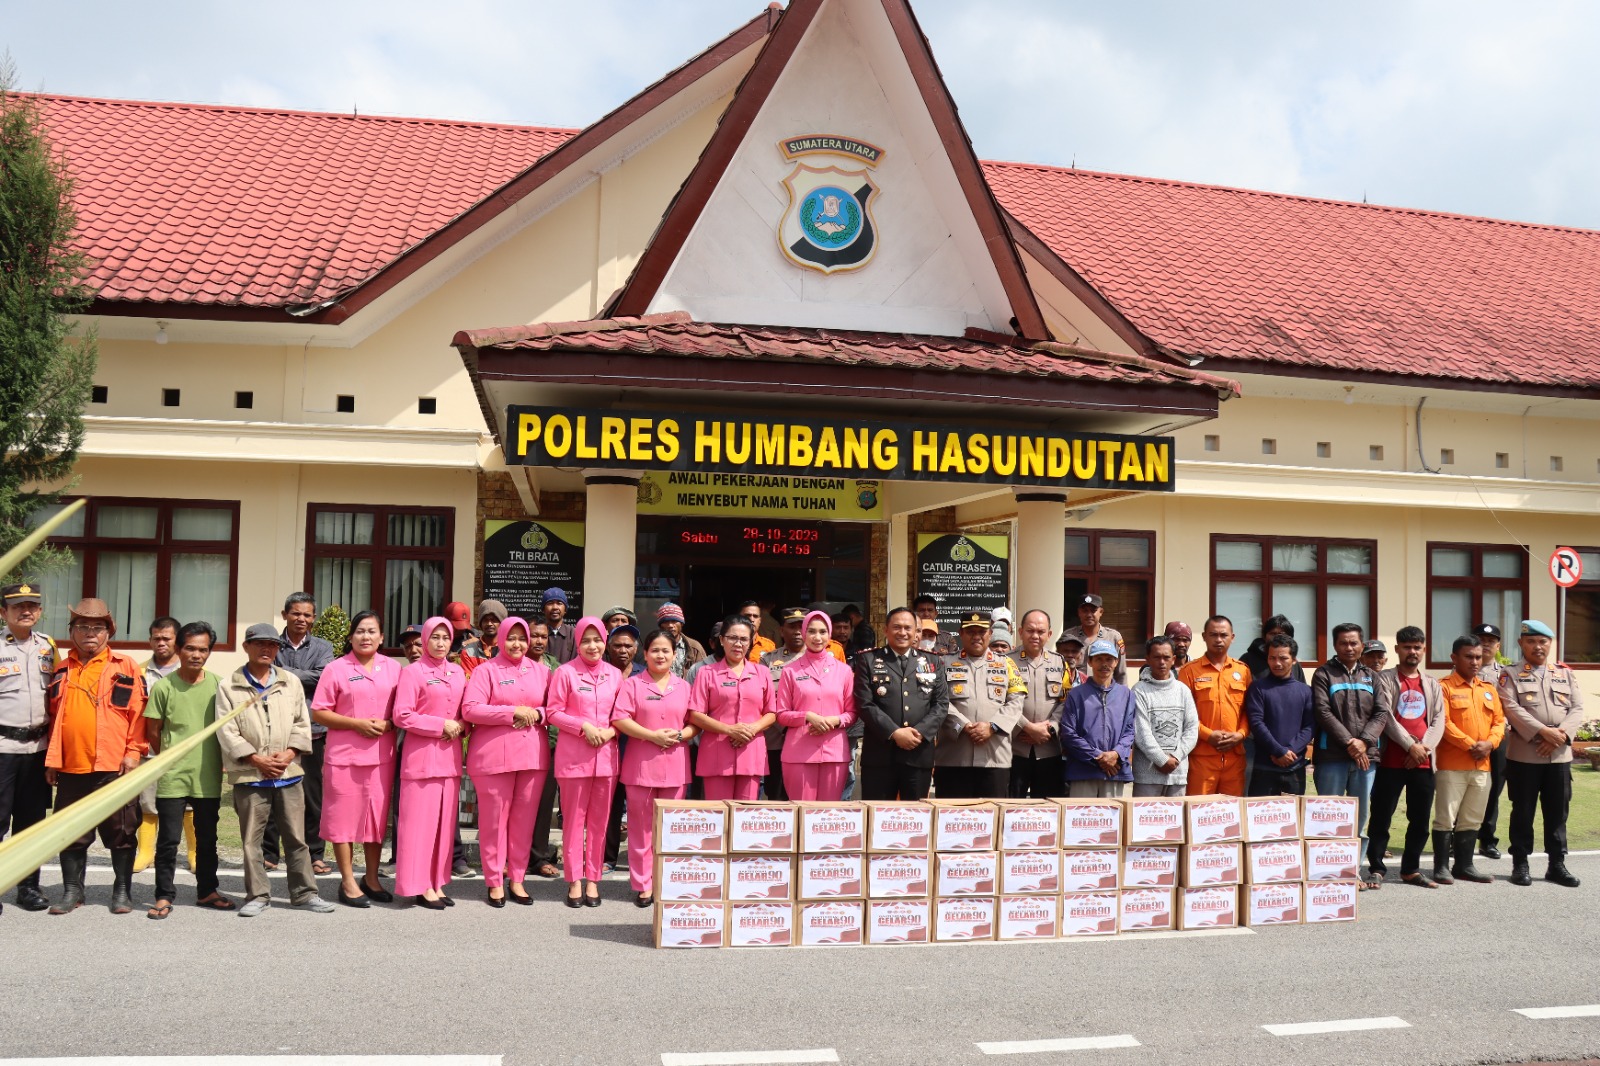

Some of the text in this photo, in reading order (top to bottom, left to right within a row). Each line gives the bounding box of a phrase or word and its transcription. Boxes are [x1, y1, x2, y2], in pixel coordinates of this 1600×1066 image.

[789, 139, 875, 159] SUMATERA UTARA
[517, 413, 1169, 482] POLRES HUMBANG HASUNDUTAN
[668, 472, 708, 485] AWALI
[713, 474, 789, 487] PEKERJAAN
[793, 479, 844, 490] DENGAN
[678, 493, 836, 510] MENYEBUT NAMA TUHAN
[681, 531, 718, 543] Sabtu
[509, 550, 560, 562] TRI BRATA
[922, 562, 1002, 573] CATUR PRASETYA
[1558, 554, 1574, 578] P
